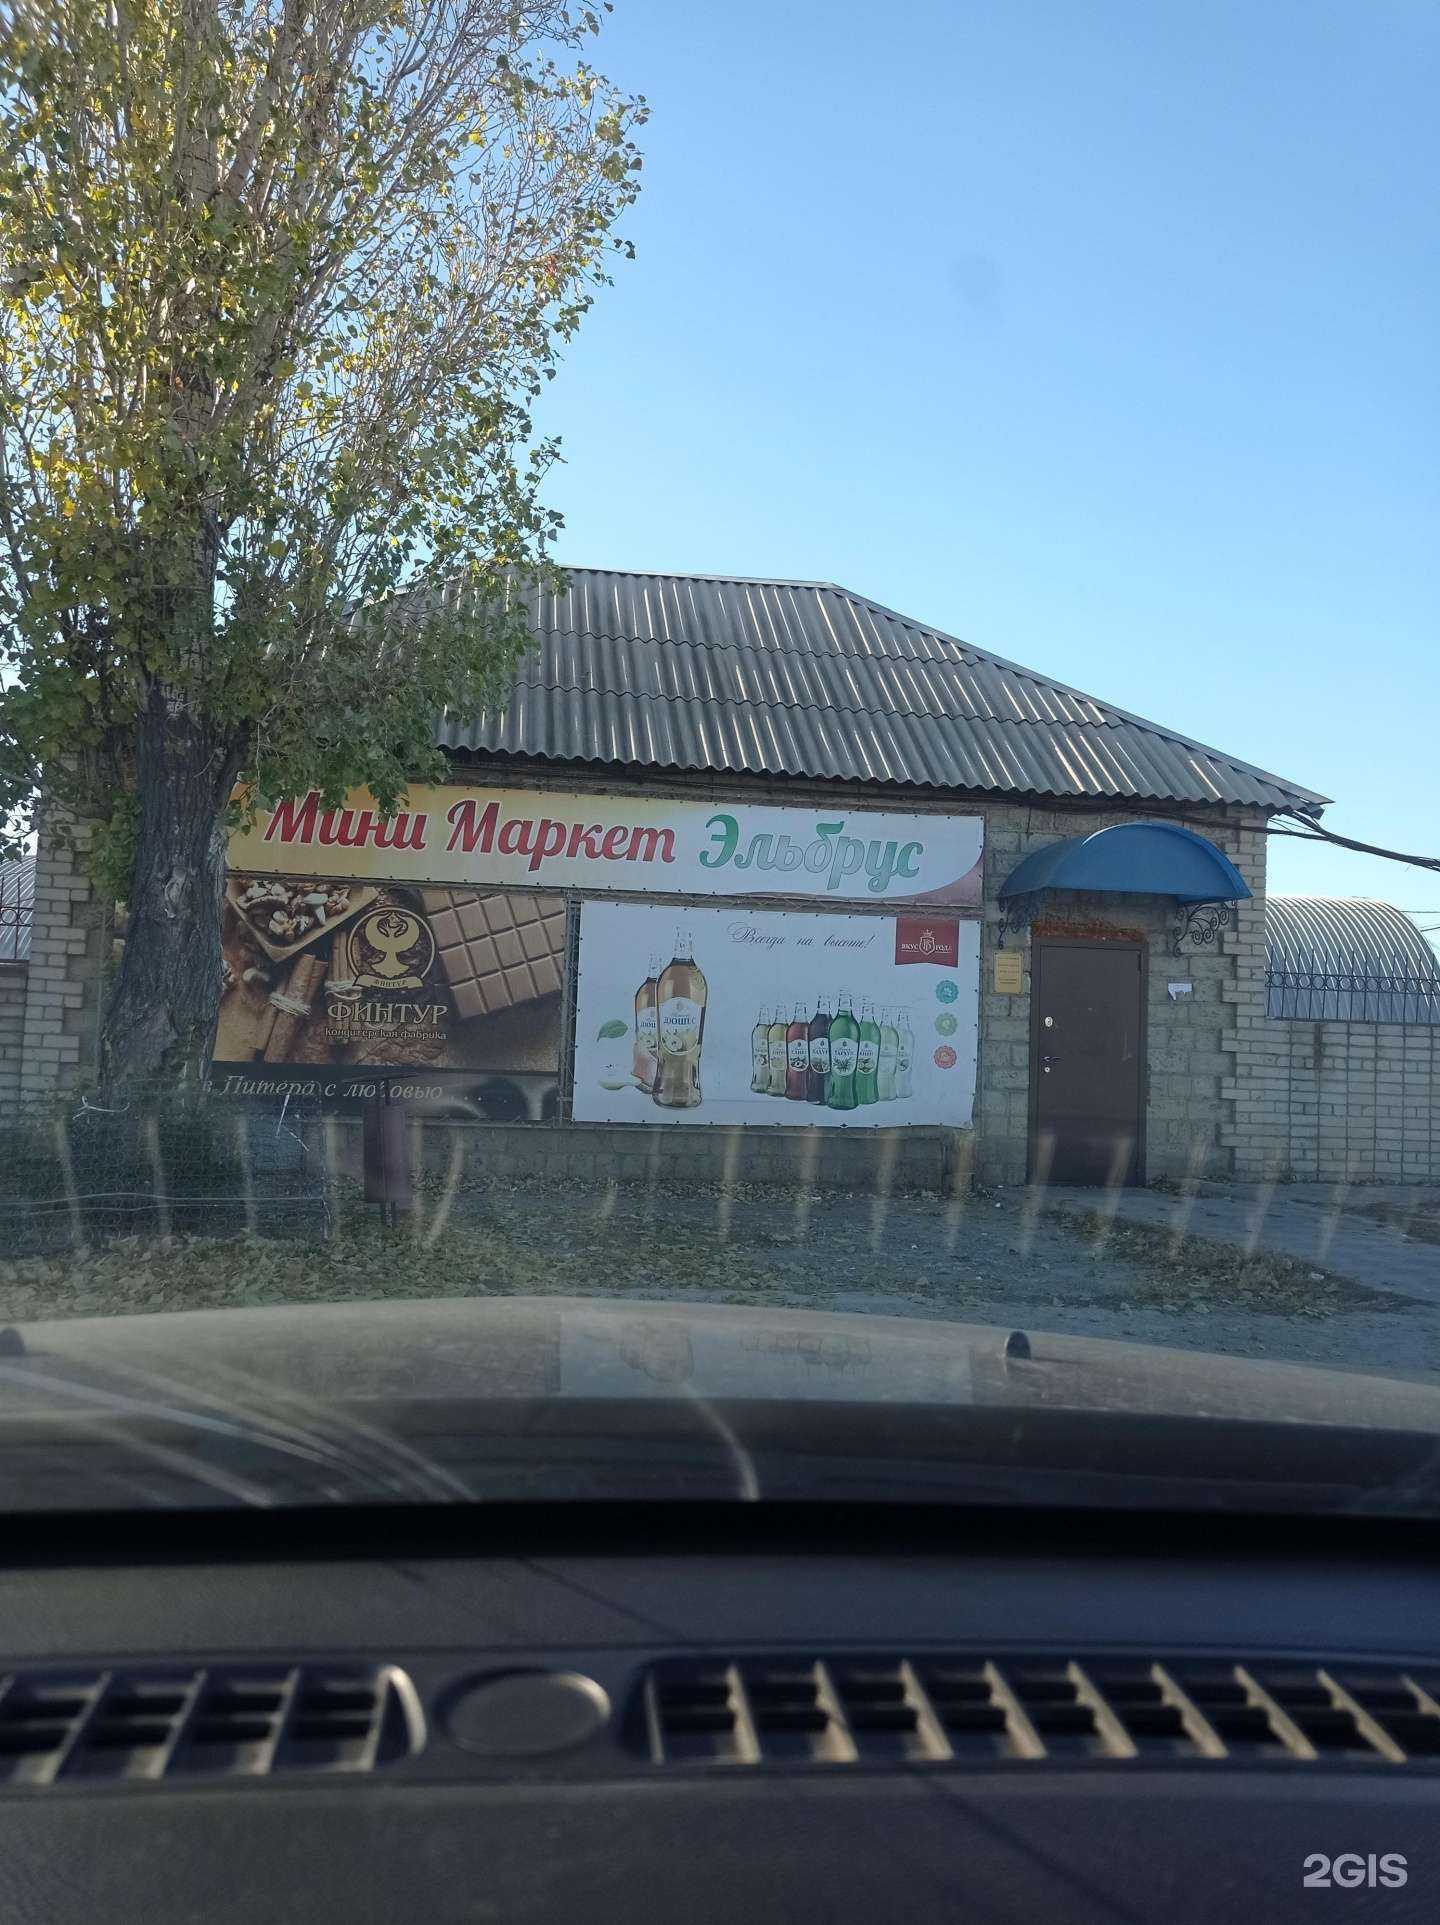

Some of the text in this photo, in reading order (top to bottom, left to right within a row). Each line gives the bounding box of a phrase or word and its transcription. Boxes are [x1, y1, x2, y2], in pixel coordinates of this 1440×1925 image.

[263, 790, 925, 893] Мини Маркет Эльбрус
[327, 1001, 449, 1025] ФИНТУР
[324, 1082, 337, 1096] с
